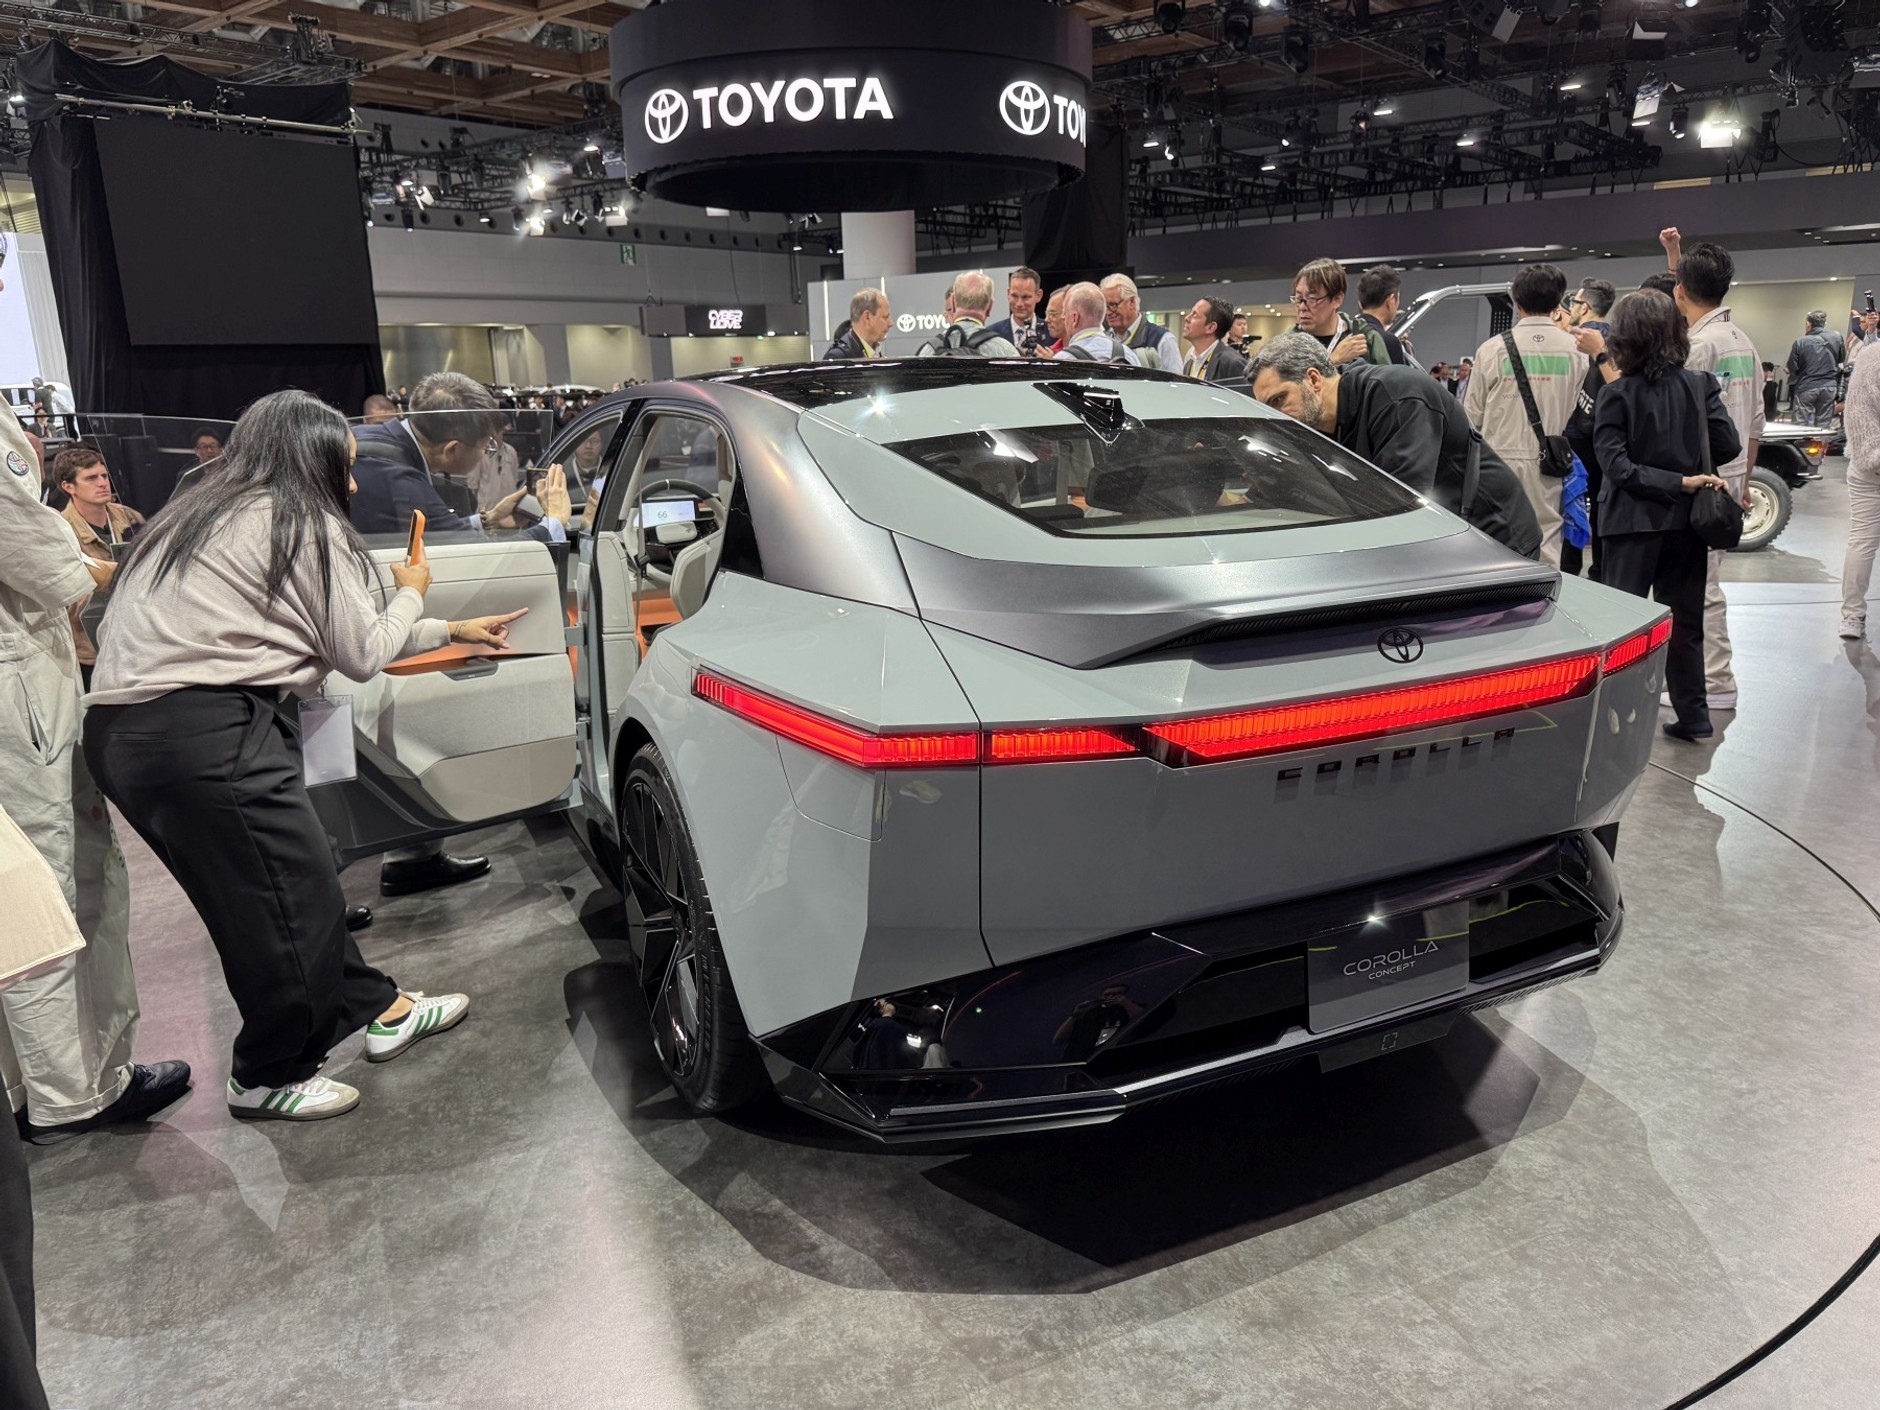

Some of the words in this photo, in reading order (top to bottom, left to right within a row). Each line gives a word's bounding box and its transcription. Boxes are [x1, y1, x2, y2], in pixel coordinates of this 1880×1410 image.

[693, 77, 894, 129] TOYOTA
[1053, 94, 1086, 149] TOY
[708, 309, 743, 322] CYBER
[709, 320, 742, 330] LOVE
[1277, 728, 1515, 781] COROLLA
[1343, 940, 1439, 976] COROLLA
[1368, 961, 1416, 980] CONCEPT
